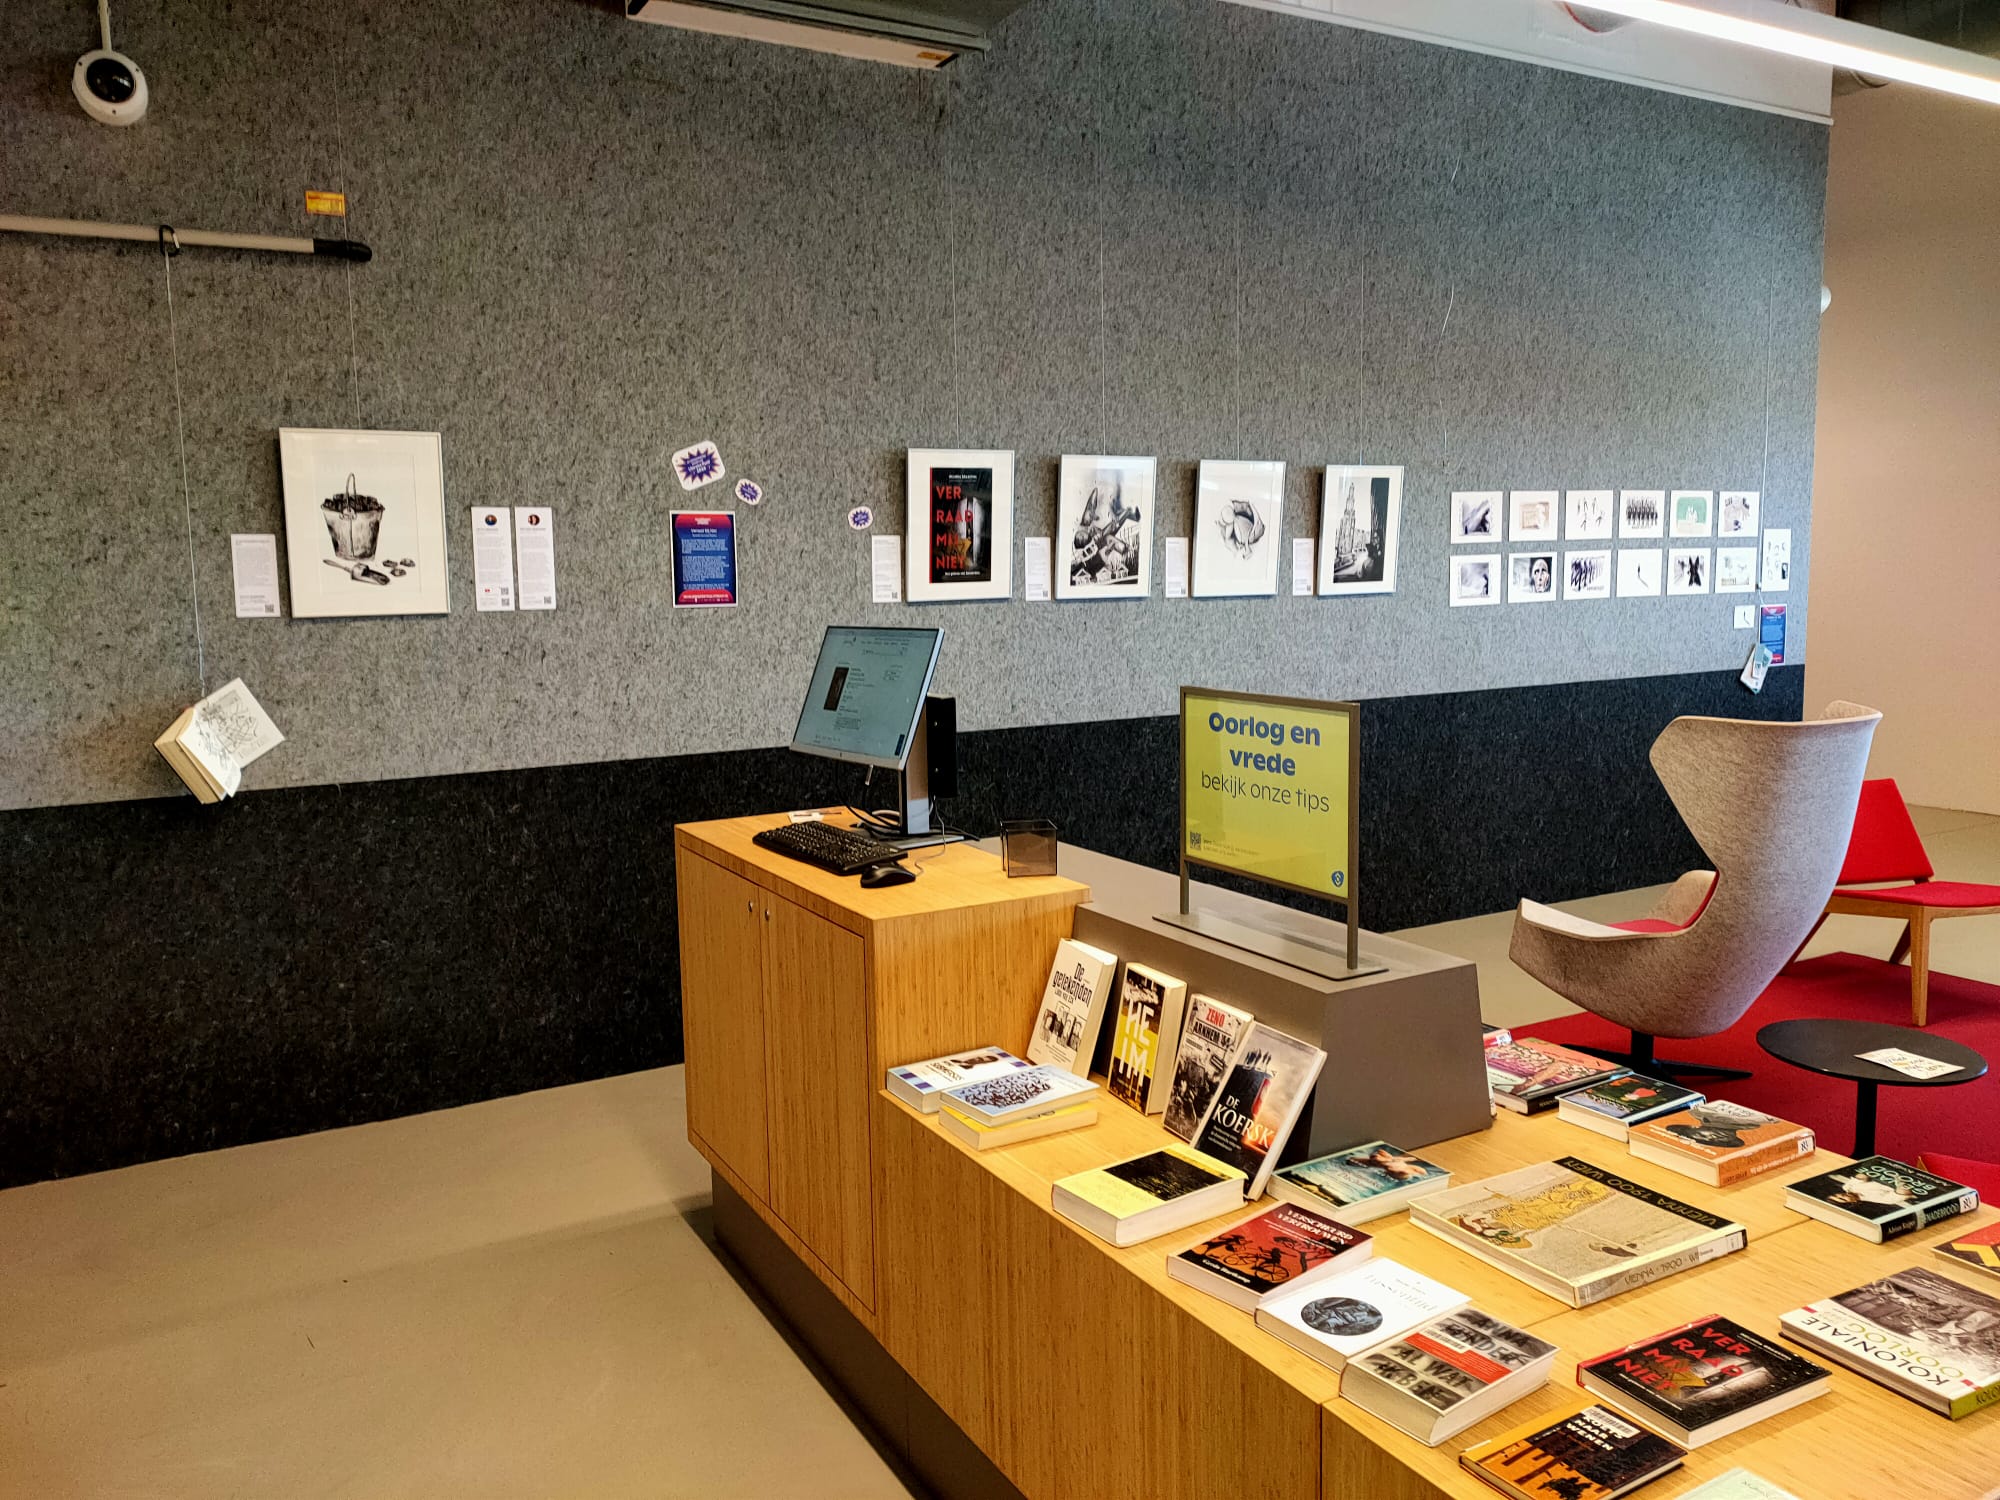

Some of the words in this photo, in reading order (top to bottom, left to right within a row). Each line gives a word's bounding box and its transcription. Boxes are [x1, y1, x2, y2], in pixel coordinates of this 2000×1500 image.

[936, 486, 962, 500] VER
[936, 509, 974, 523] RAAD
[936, 554, 967, 569] NIET
[1209, 712, 1285, 746] Oorlog
[1290, 725, 1321, 746] en
[1230, 749, 1296, 776] vrede
[1201, 771, 1246, 799] bekijk
[1250, 783, 1291, 805] onze
[1296, 788, 1330, 814] tips
[1074, 962, 1085, 982] De
[1206, 1007, 1225, 1028] ZENO
[1193, 1021, 1220, 1045] ARNHEM
[1226, 1094, 1241, 1110] DE
[1212, 1103, 1275, 1149] KOERSK
[1564, 1159, 1605, 1181] WIEN
[1871, 1166, 1937, 1191] BROOD
[1610, 1179, 1653, 1203] 1900
[1657, 1198, 1718, 1227] VIENNA
[1699, 1328, 1751, 1355] VER
[1801, 1316, 1950, 1386] KOLONIALE
[1671, 1338, 1744, 1377] RAAD
[1615, 1358, 1678, 1391] NIET
[1566, 1422, 1614, 1451] WENEN
[1573, 1418, 1609, 1440] NAAR
